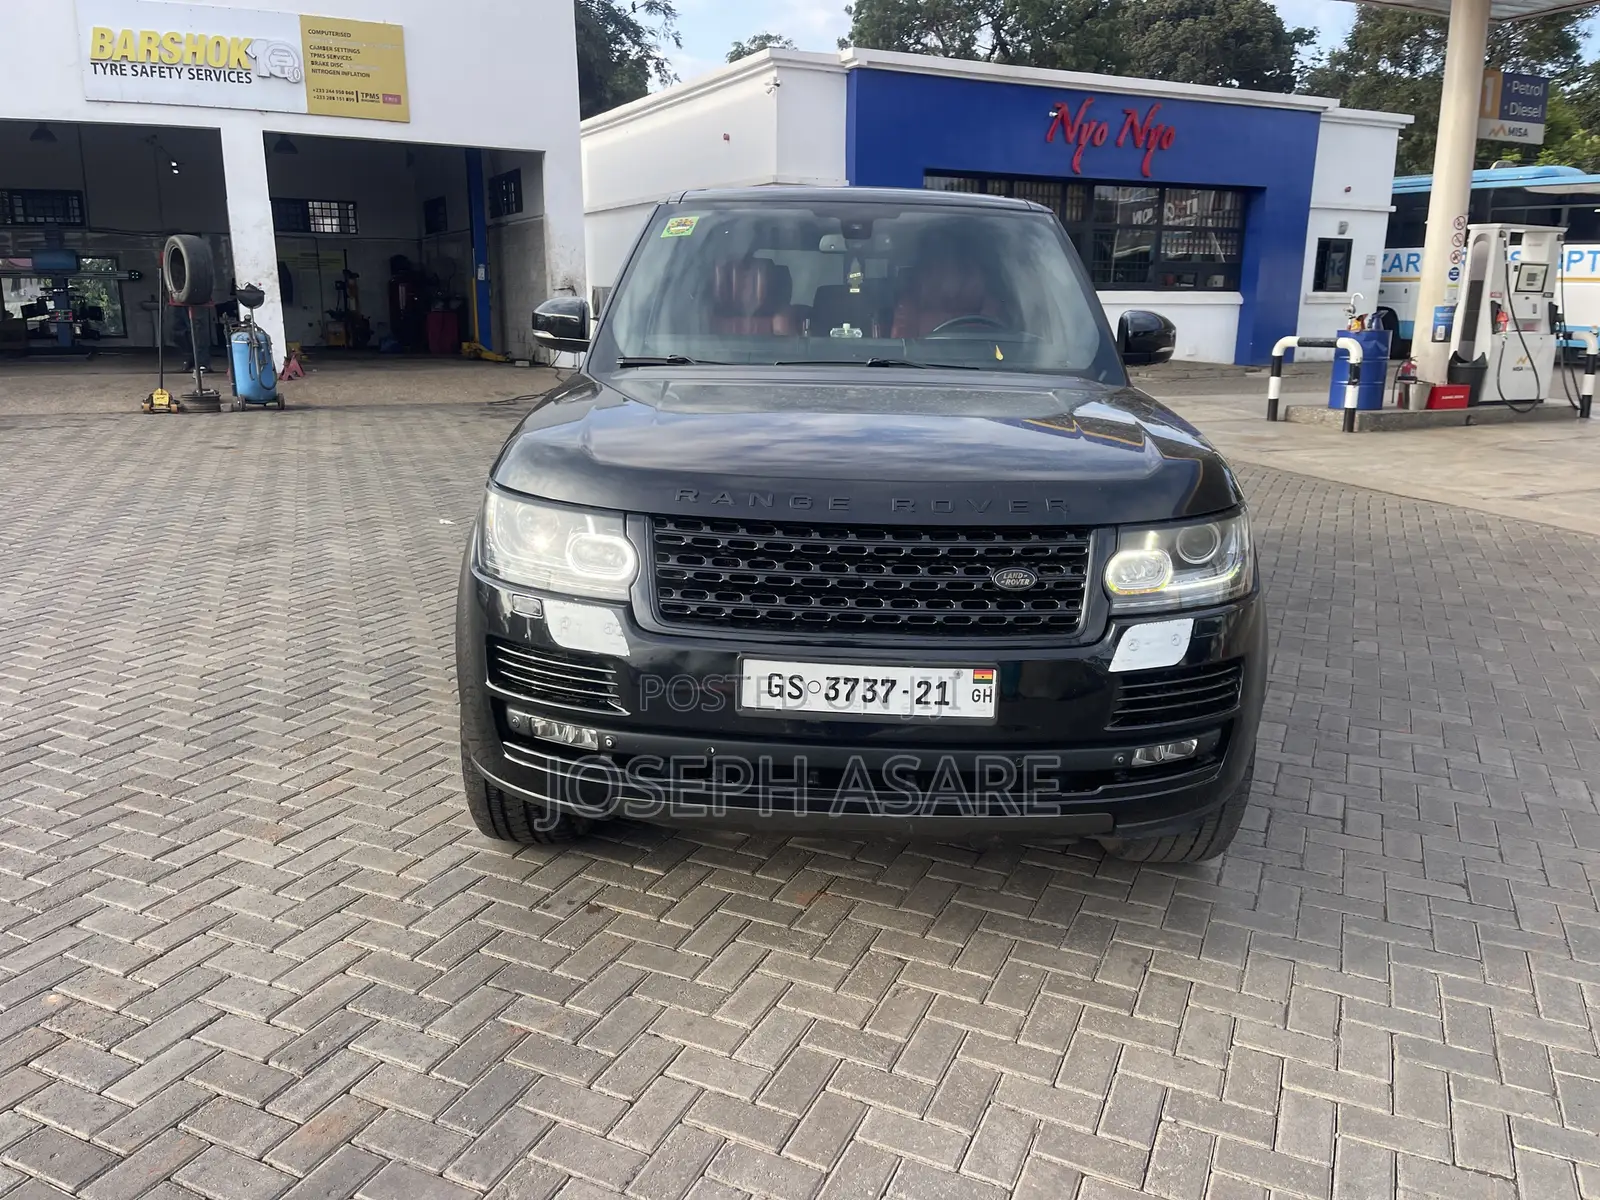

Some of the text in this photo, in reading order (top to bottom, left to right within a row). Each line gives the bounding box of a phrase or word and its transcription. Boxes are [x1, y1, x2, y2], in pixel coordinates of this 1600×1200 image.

[308, 29, 351, 38] COMPUTERISED
[90, 27, 254, 70] BARSHOK
[91, 62, 252, 84] TYRE SAFETY SERVICES
[311, 68, 340, 76] NITROGEN
[361, 92, 379, 100] TPMS
[1511, 80, 1544, 96] Petrol
[1509, 102, 1543, 117] Diesel
[1046, 97, 1176, 178] Nyo Nyo
[1508, 126, 1528, 137] MISA
[675, 488, 1069, 515] RANGE ROVER
[1005, 578, 1030, 586] ROVER
[767, 672, 804, 700] GS
[971, 688, 993, 704] GH
